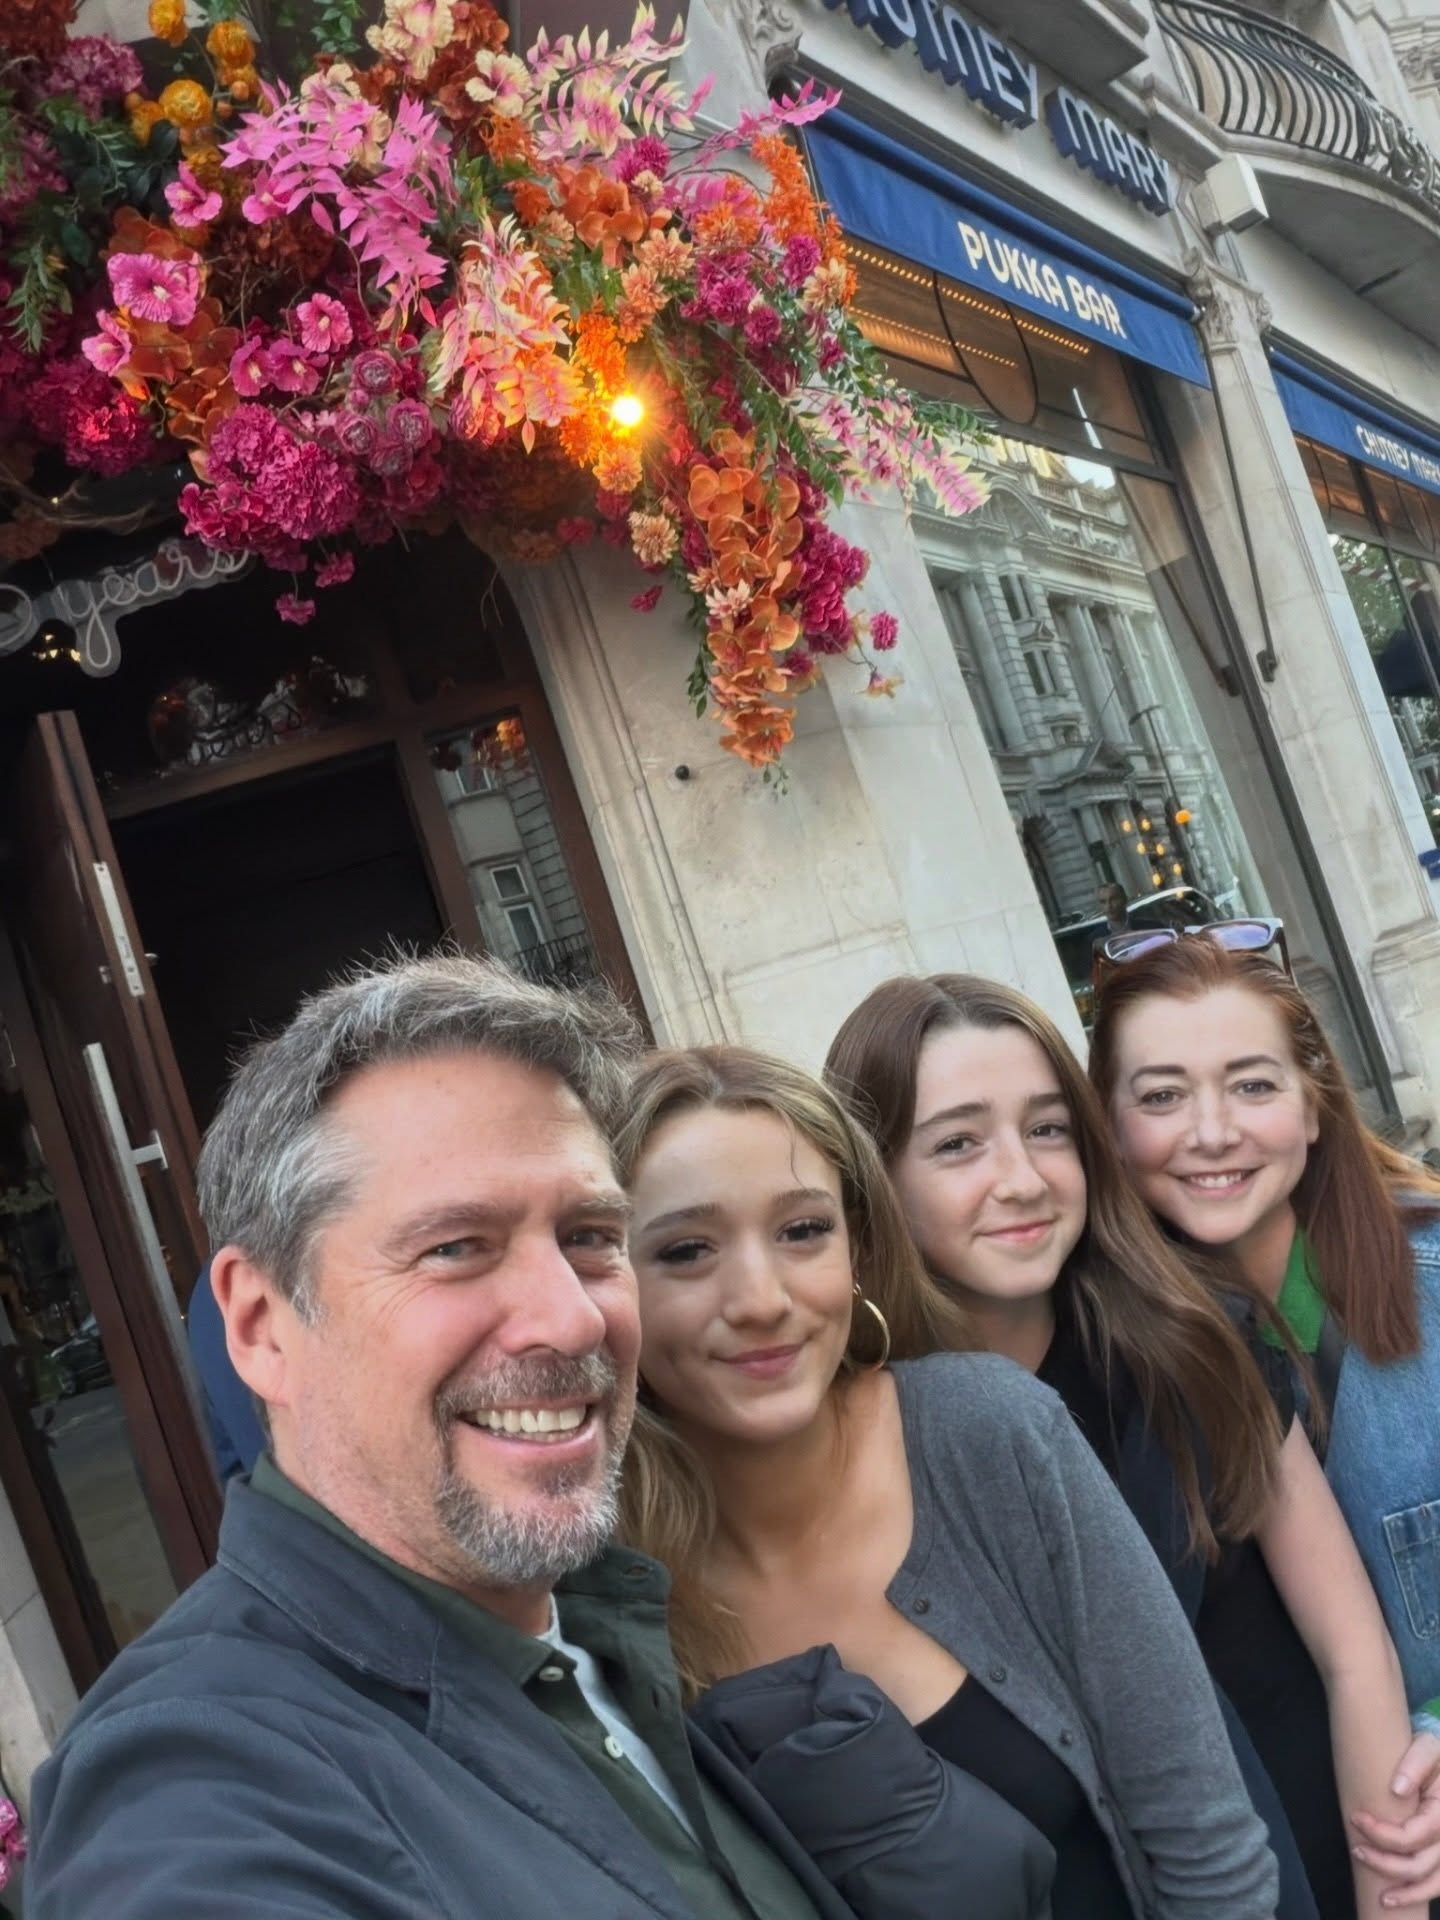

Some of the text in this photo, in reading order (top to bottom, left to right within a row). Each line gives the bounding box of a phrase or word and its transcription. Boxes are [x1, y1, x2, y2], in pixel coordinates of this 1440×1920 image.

[1053, 86, 1175, 212] MARY
[957, 221, 1127, 340] PUKKA BAR
[56, 545, 251, 669] years
